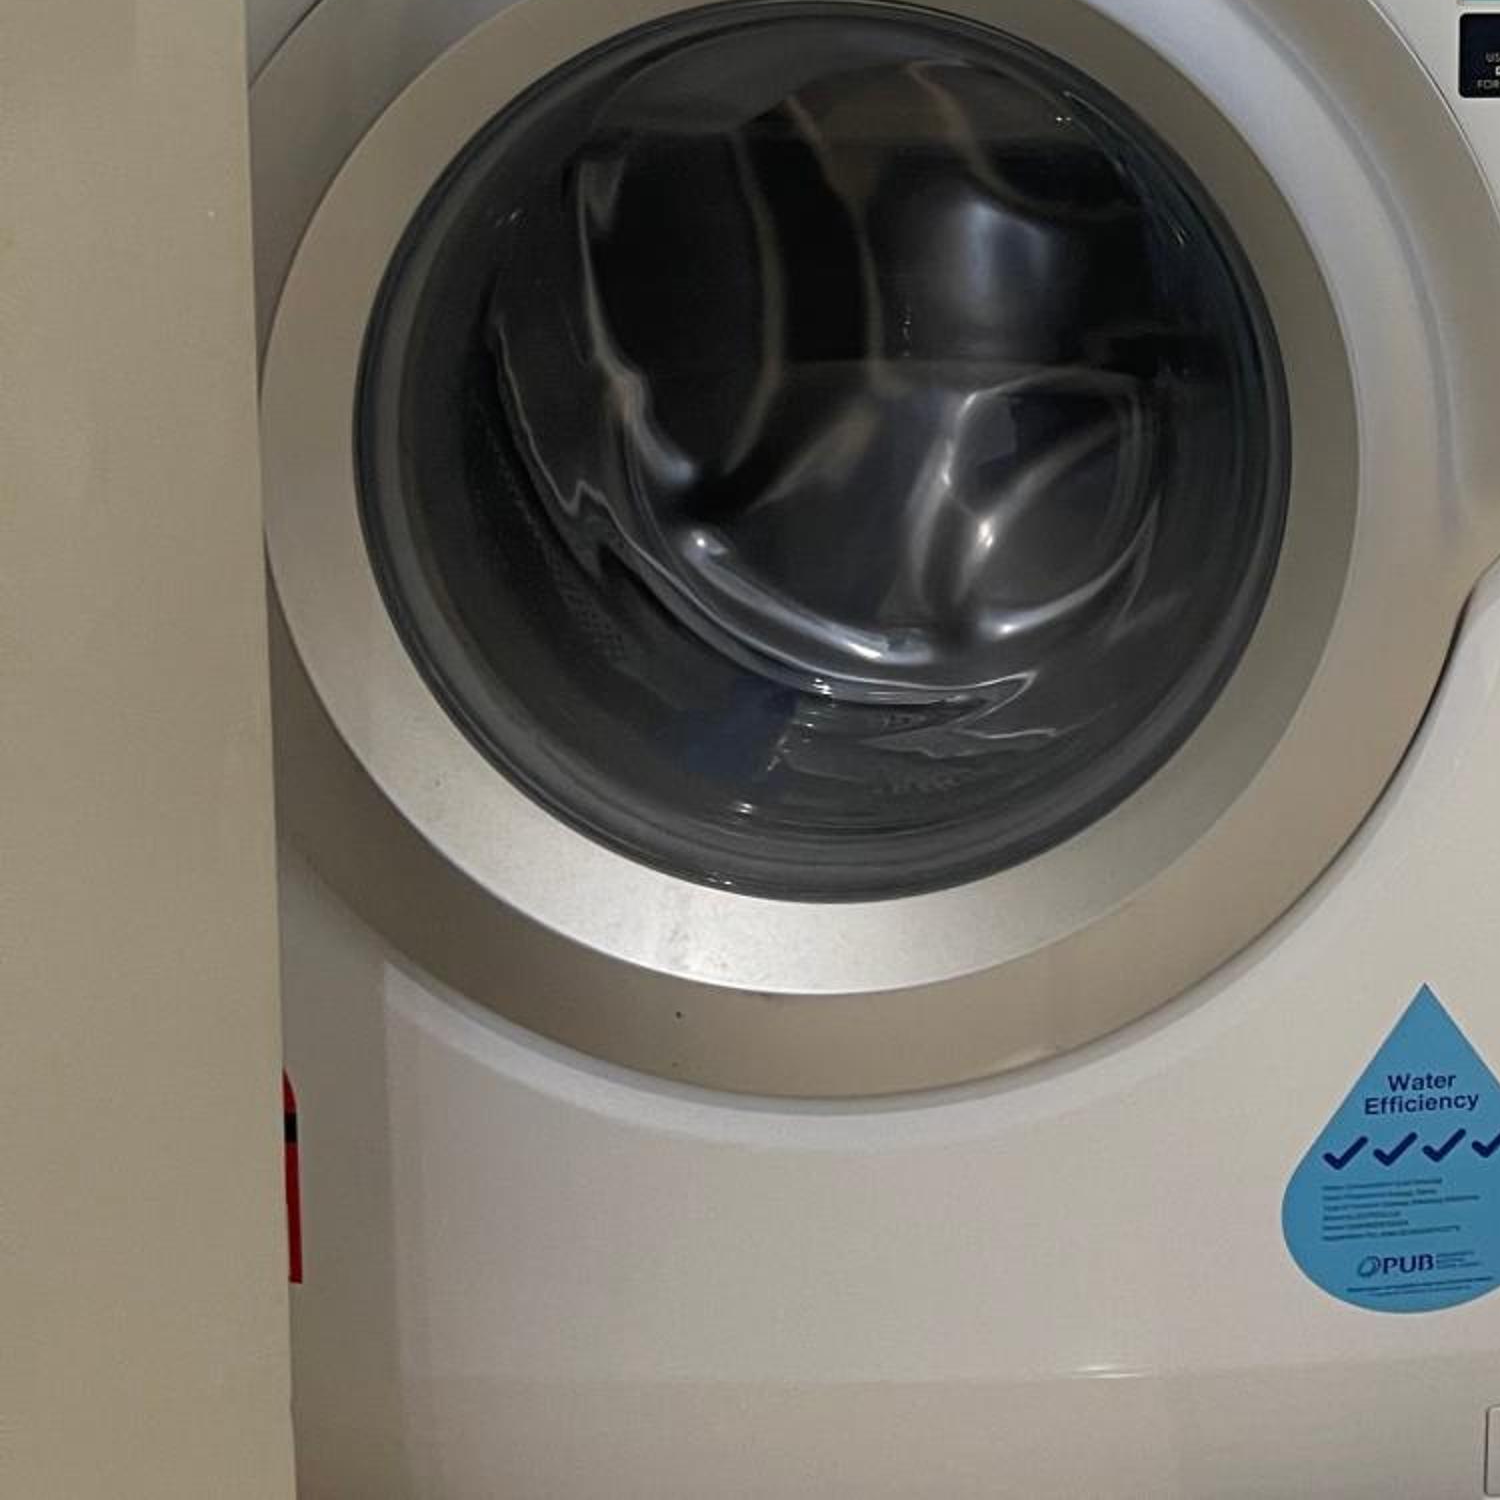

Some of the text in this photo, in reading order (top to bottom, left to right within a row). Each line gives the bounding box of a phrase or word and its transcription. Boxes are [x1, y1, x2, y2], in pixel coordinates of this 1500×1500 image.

[1477, 79, 1500, 90] FOR
[1387, 1073, 1457, 1092] Water
[1364, 1093, 1480, 1116] Efficiency
[1383, 1253, 1435, 1275] PUB
